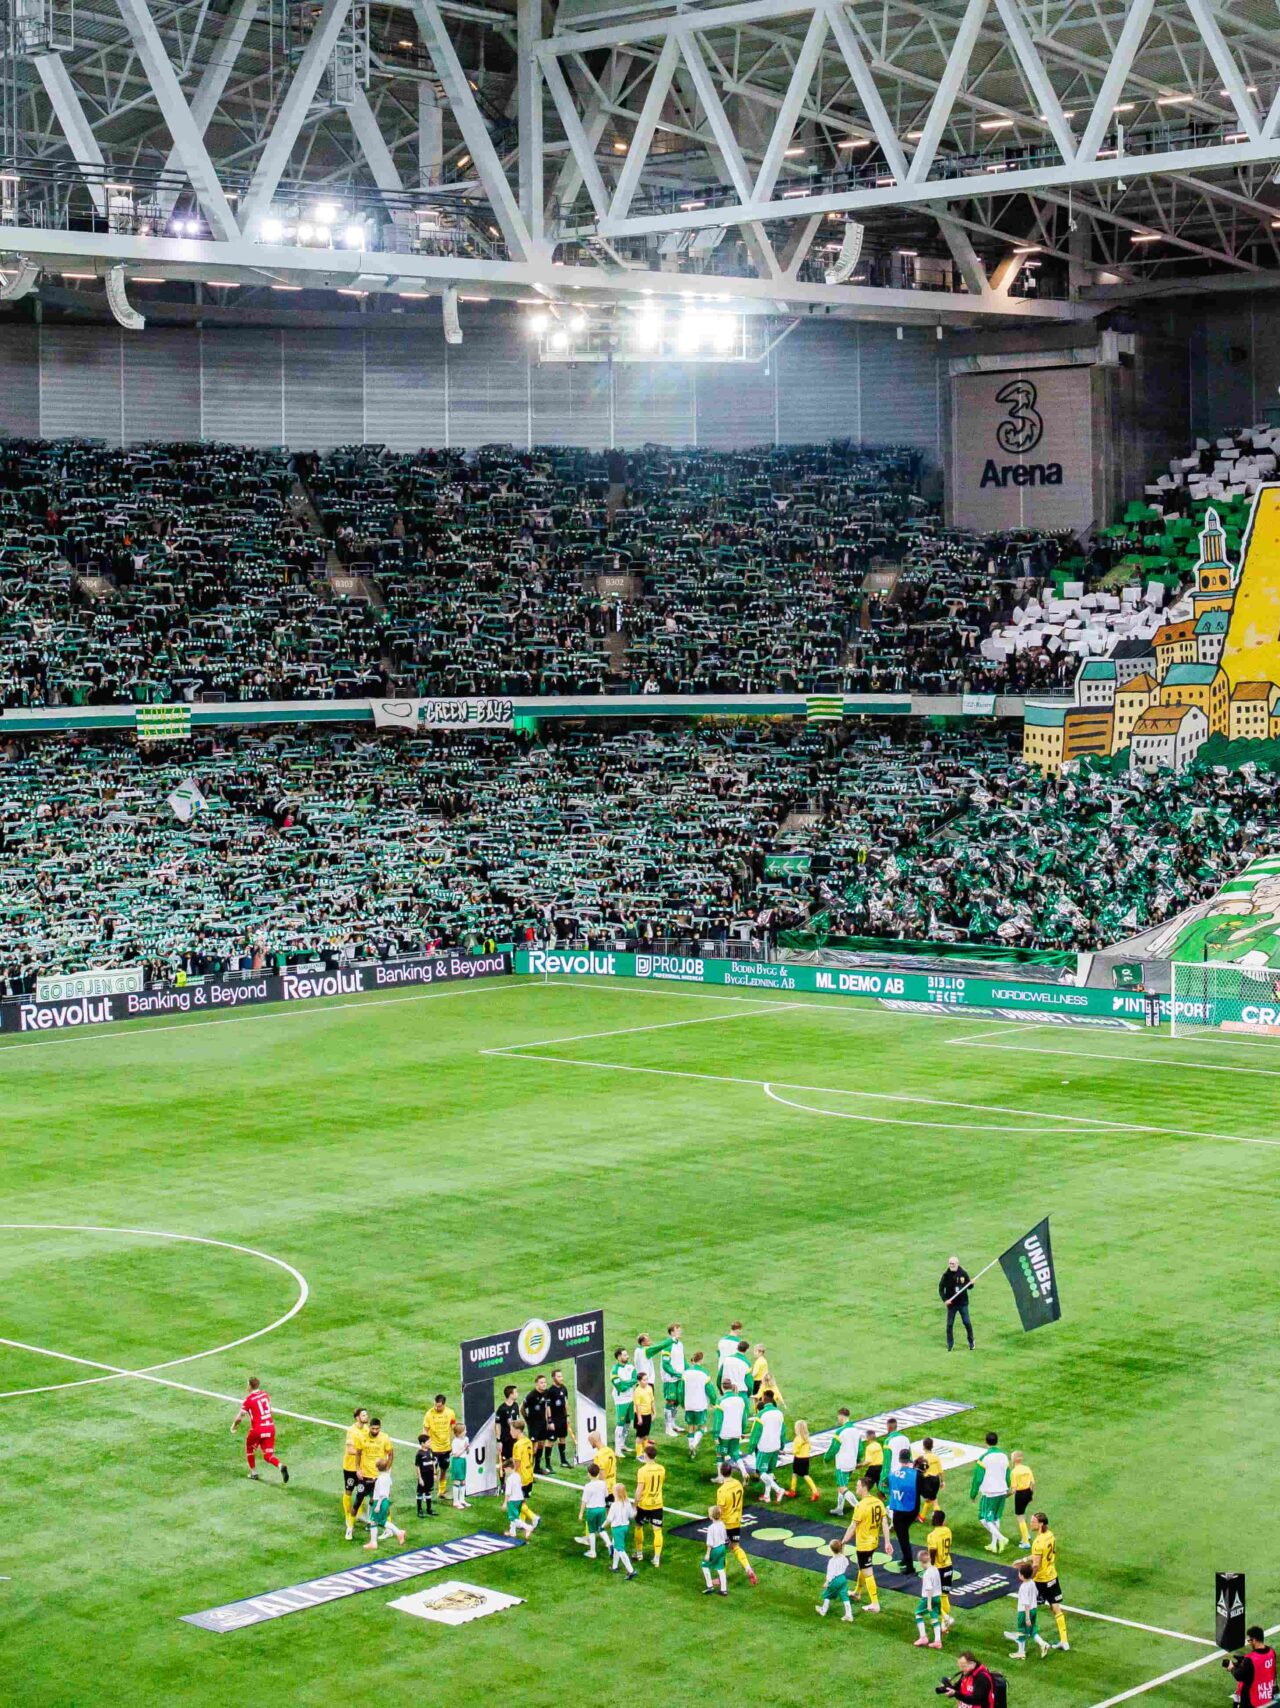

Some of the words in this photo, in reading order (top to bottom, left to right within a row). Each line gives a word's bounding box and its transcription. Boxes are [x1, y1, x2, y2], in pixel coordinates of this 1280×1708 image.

[979, 459, 1063, 488] Arena
[426, 700, 469, 723] GREEN
[477, 699, 513, 723] BOYS
[376, 963, 433, 984] Banking
[436, 962, 447, 977] &
[451, 955, 505, 978] Beyond
[529, 950, 615, 975] Revolut
[653, 954, 704, 976] PROJOB
[779, 967, 788, 977] &
[39, 982, 62, 1001] GO
[66, 977, 114, 998] BAJEN
[283, 969, 364, 999] Revolut
[781, 977, 795, 989] AB
[816, 972, 836, 989] ML
[839, 975, 880, 992] DEMO
[884, 978, 904, 994] AB
[128, 992, 190, 1013] Banking
[194, 988, 207, 1005] &
[212, 981, 267, 1006] Beyond
[991, 988, 1088, 1006] NORDICWELLNESS
[1125, 996, 1212, 1019] INTRSPORT
[21, 997, 113, 1031] Revolut
[558, 1321, 596, 1341] UNIBET
[470, 1341, 511, 1362] UNIBET
[257, 1398, 271, 1415] 13
[587, 1416, 597, 1433] U
[475, 1446, 485, 1465] U
[893, 1490, 904, 1501] TV
[872, 1505, 881, 1524] 18
[252, 1534, 516, 1617] ALLSVENSKAN
[949, 1573, 1007, 1595] UNIBET
